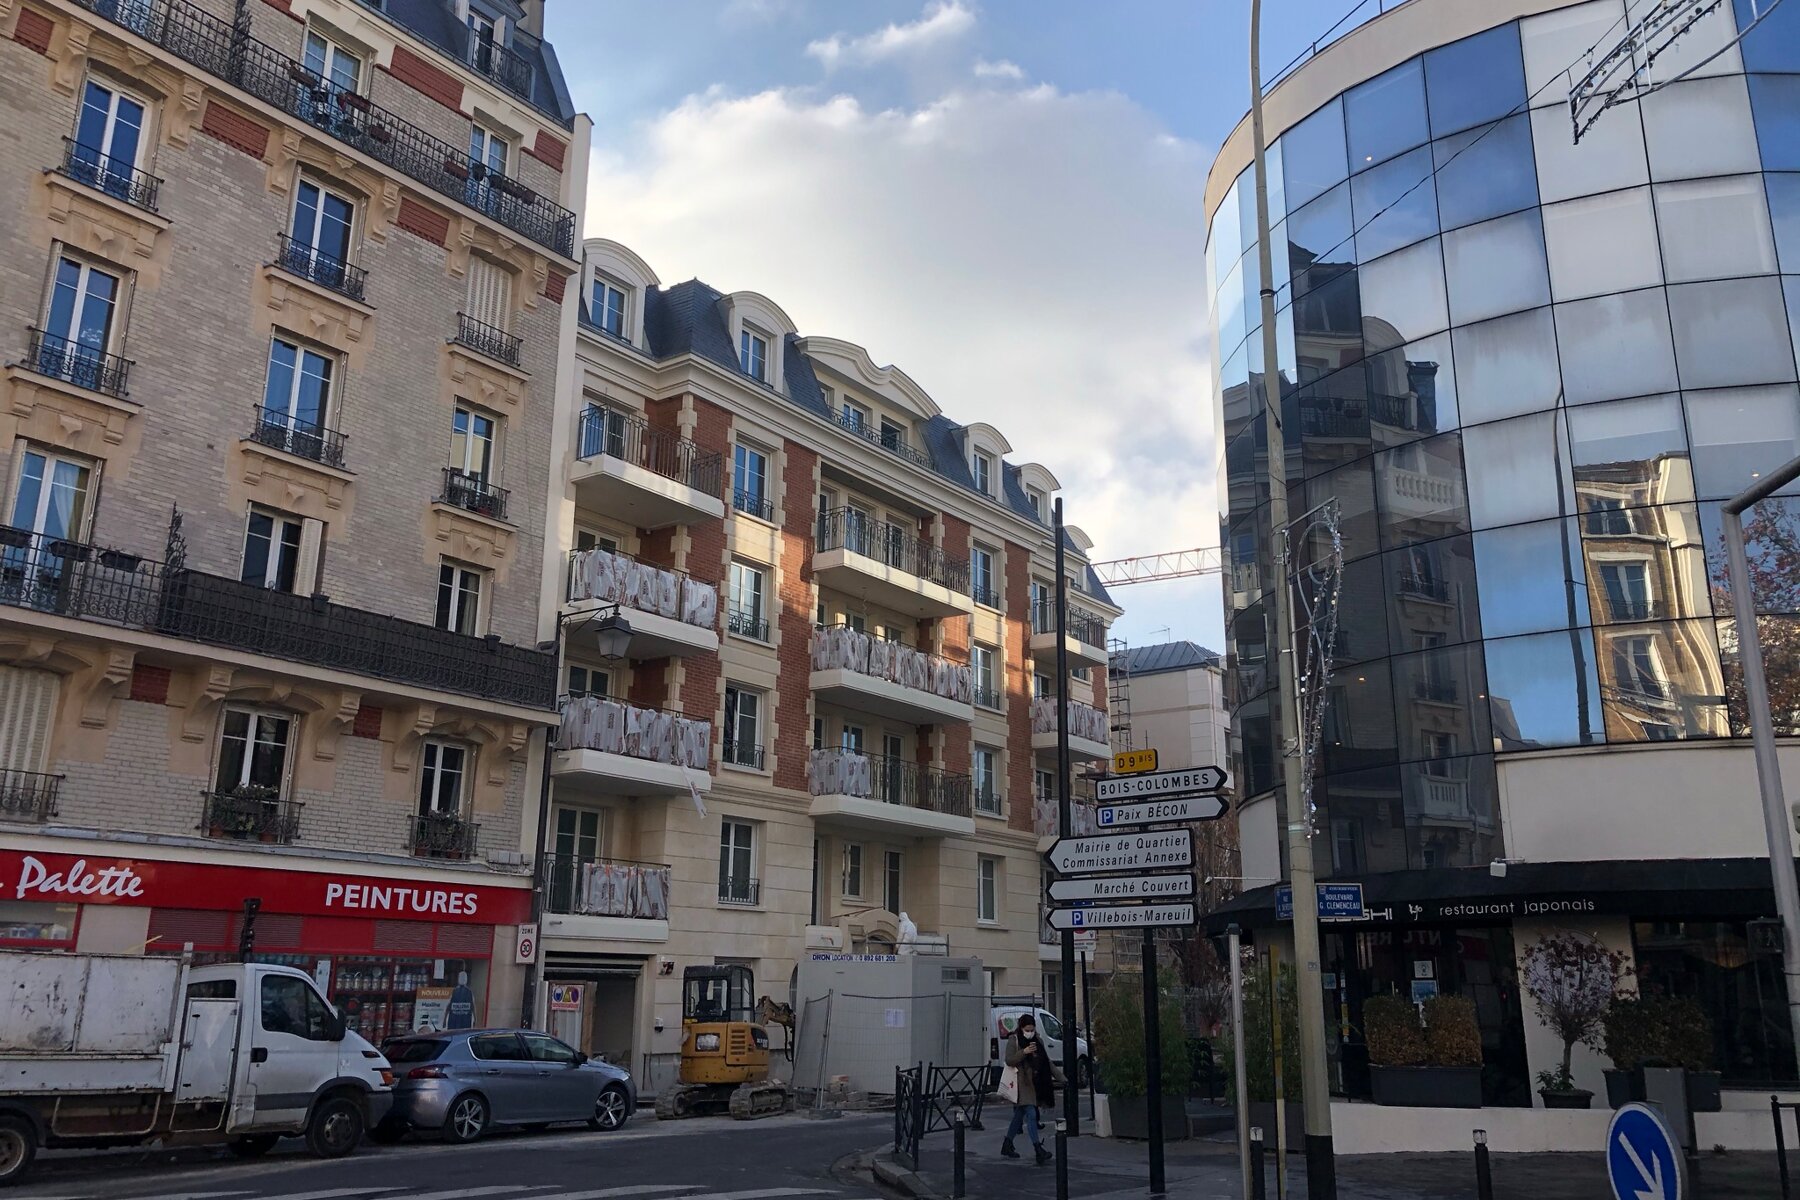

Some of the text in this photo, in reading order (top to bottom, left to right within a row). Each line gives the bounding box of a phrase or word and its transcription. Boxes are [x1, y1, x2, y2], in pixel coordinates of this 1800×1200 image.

[1118, 757, 1125, 768] D
[1129, 756, 1135, 767] 9
[1100, 773, 1209, 796] BOIS-COLOMBES
[1117, 807, 1141, 821] Paix
[1147, 803, 1188, 818] BÉCON
[1075, 836, 1187, 854] Mairie de Quartier
[1062, 851, 1188, 869] Commissariat Annexe
[16, 856, 144, 899] Palette
[1094, 879, 1189, 895] Marché Couvert
[325, 883, 478, 915] PEINTURES
[1325, 893, 1354, 901] BOULEVARD
[1087, 908, 1191, 924] Villebois-Mareuil
[1439, 902, 1515, 916] restaurant
[1523, 898, 1595, 915] japonais
[522, 944, 530, 952] 30
